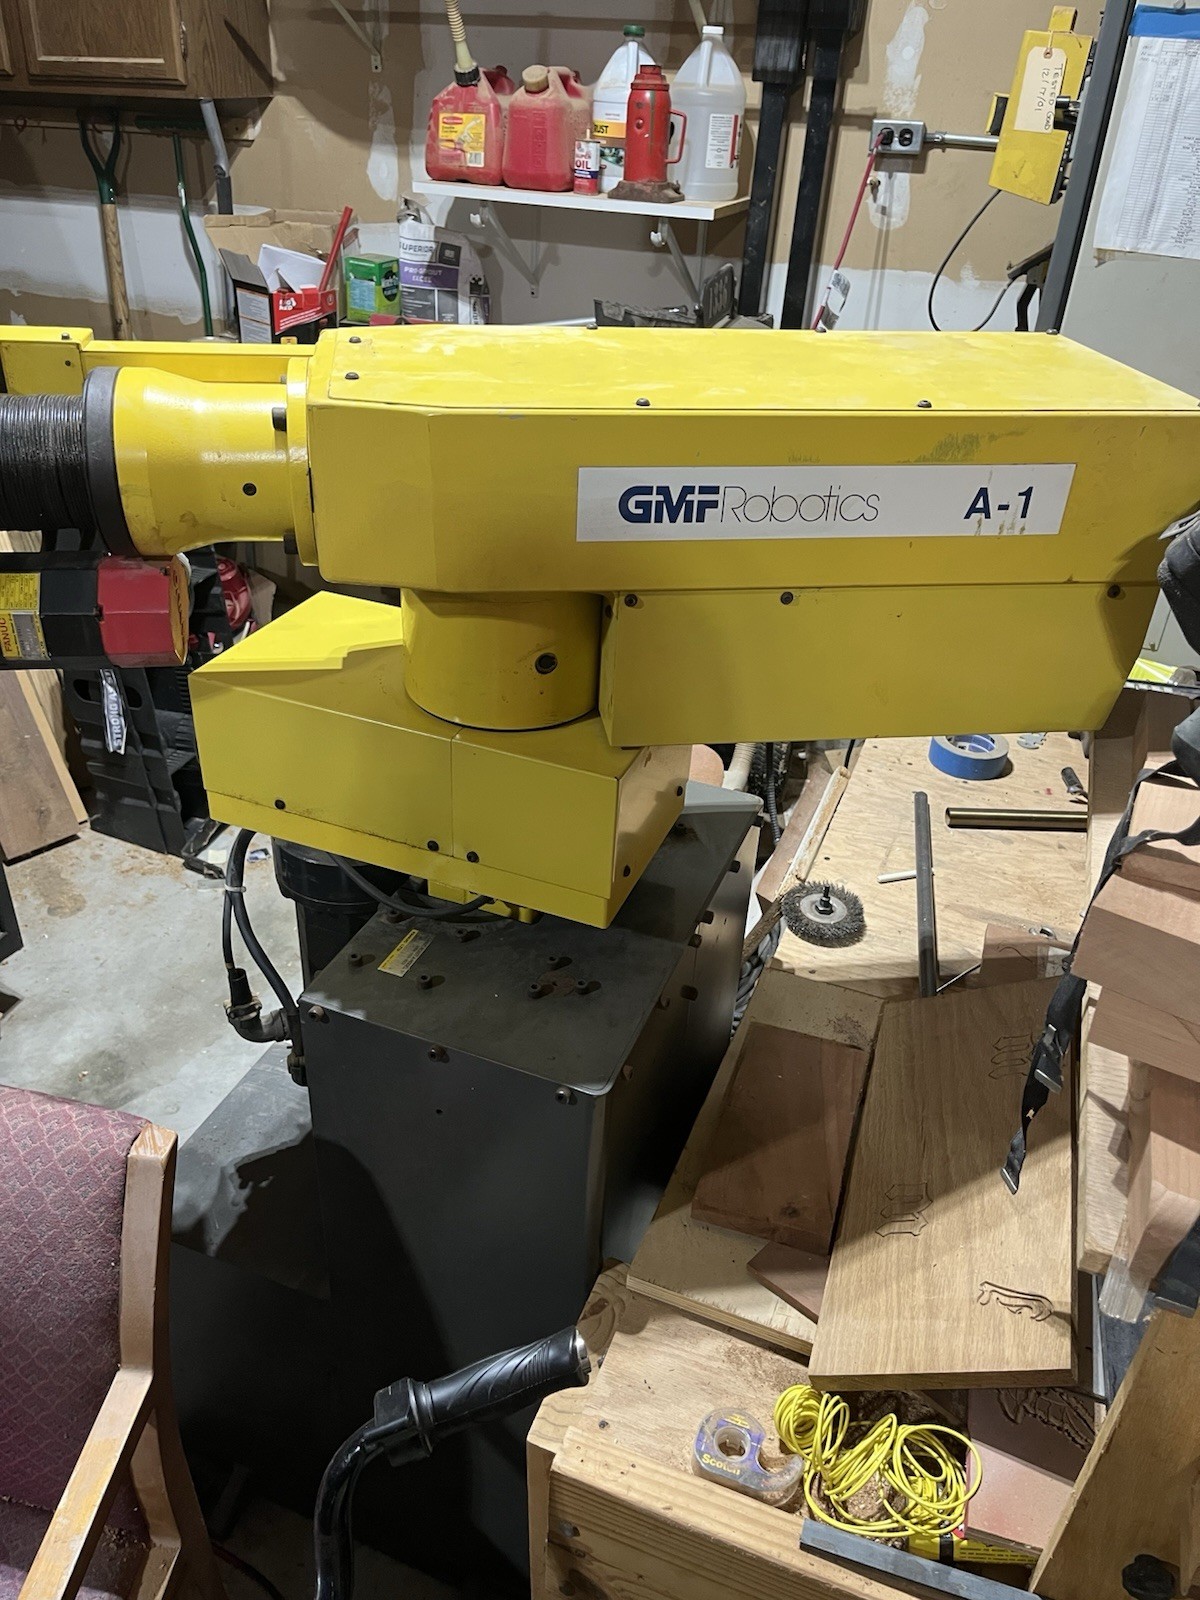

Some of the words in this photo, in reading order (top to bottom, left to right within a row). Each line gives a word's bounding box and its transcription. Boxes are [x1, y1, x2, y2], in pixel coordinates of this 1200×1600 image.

[1049, 63, 1063, 105] TESTED
[575, 159, 591, 169] OIL
[963, 486, 1034, 520] A-1
[0, 617, 12, 652] FANUC
